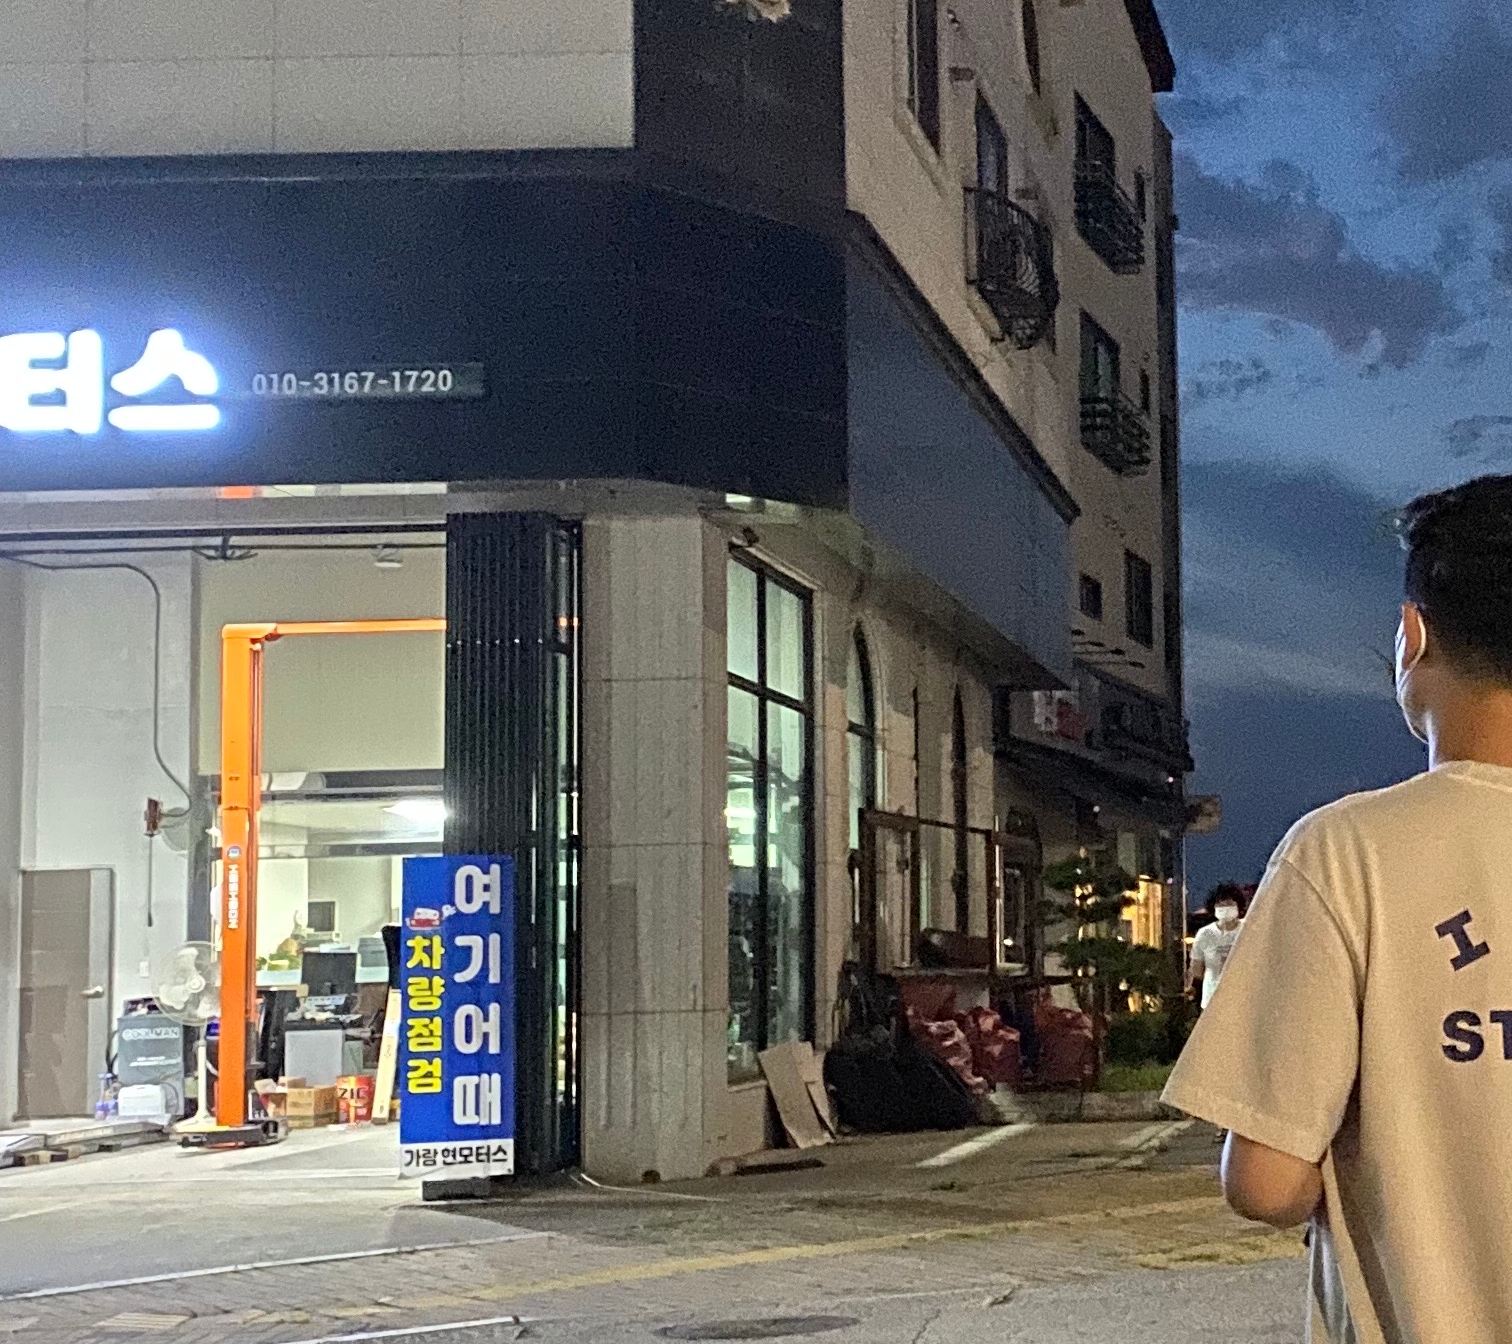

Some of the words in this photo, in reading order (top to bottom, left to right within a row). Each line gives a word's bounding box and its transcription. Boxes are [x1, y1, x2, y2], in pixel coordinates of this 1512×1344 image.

[0, 328, 220, 434] 터스
[252, 369, 453, 395] 010-3167-1720
[406, 934, 446, 1094] 차량점검
